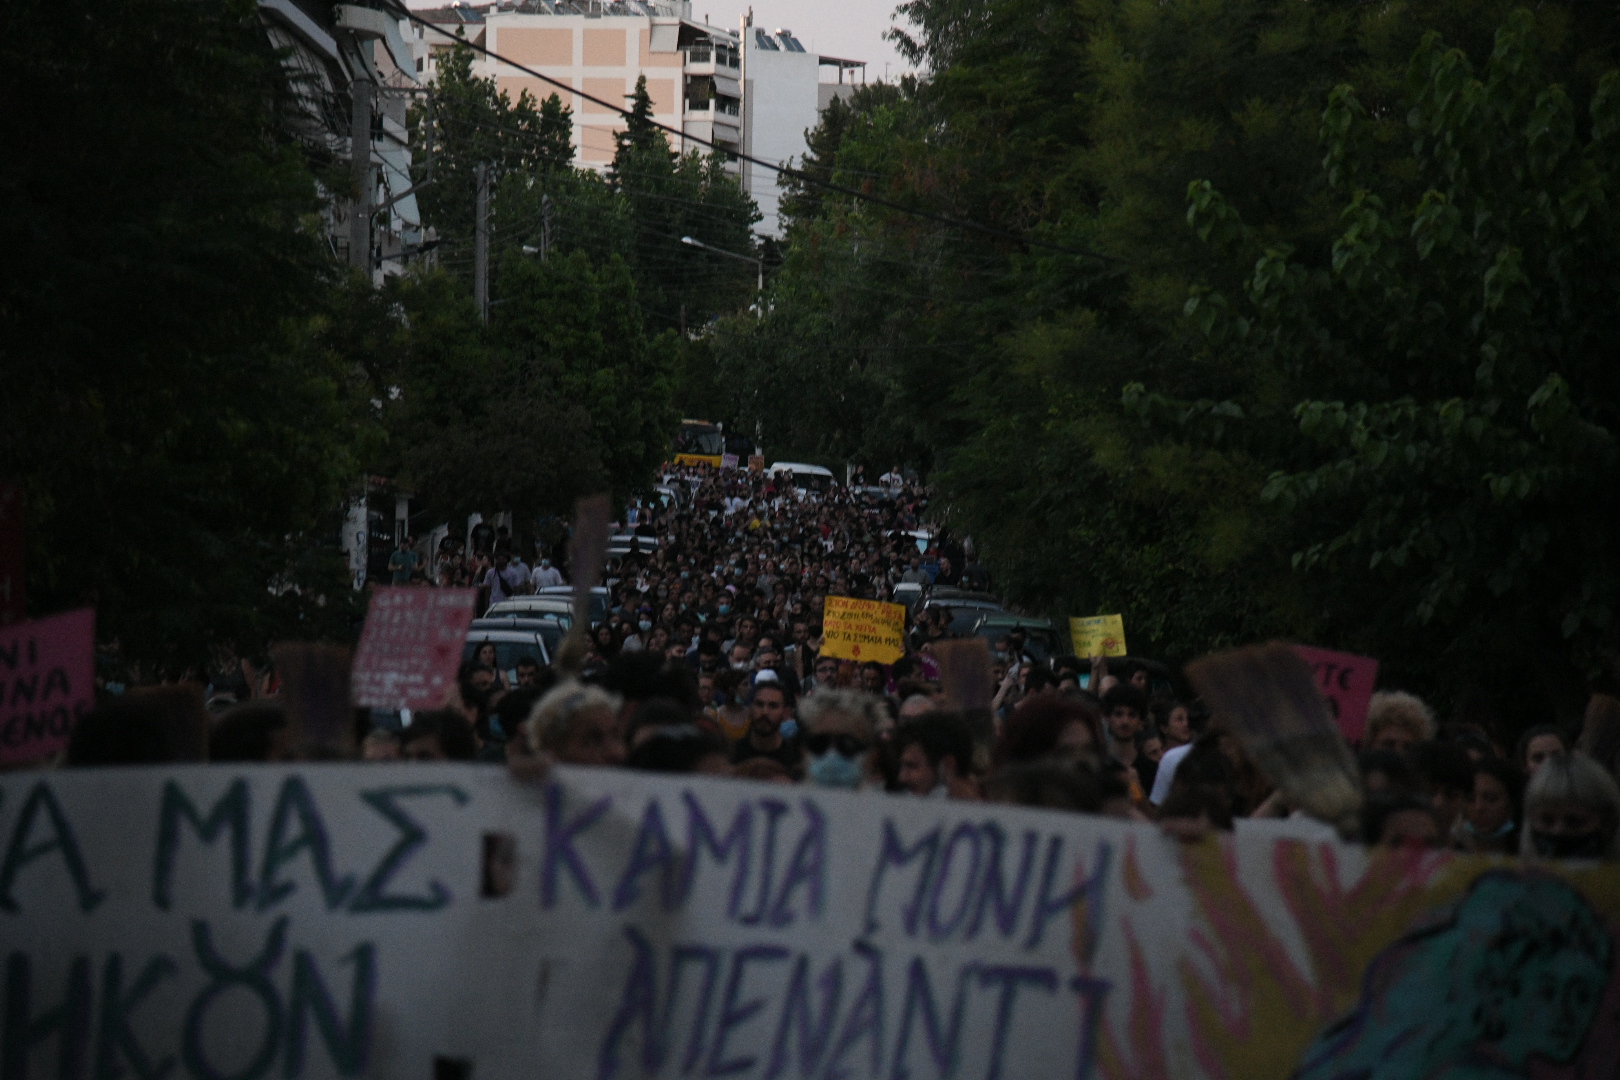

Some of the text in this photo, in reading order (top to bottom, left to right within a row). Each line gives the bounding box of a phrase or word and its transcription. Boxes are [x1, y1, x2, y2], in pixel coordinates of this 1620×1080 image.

[153, 775, 470, 915] ΜΑΣ
[541, 780, 1112, 950] ΚΑΜΙΑ ΜΟΝΗ
